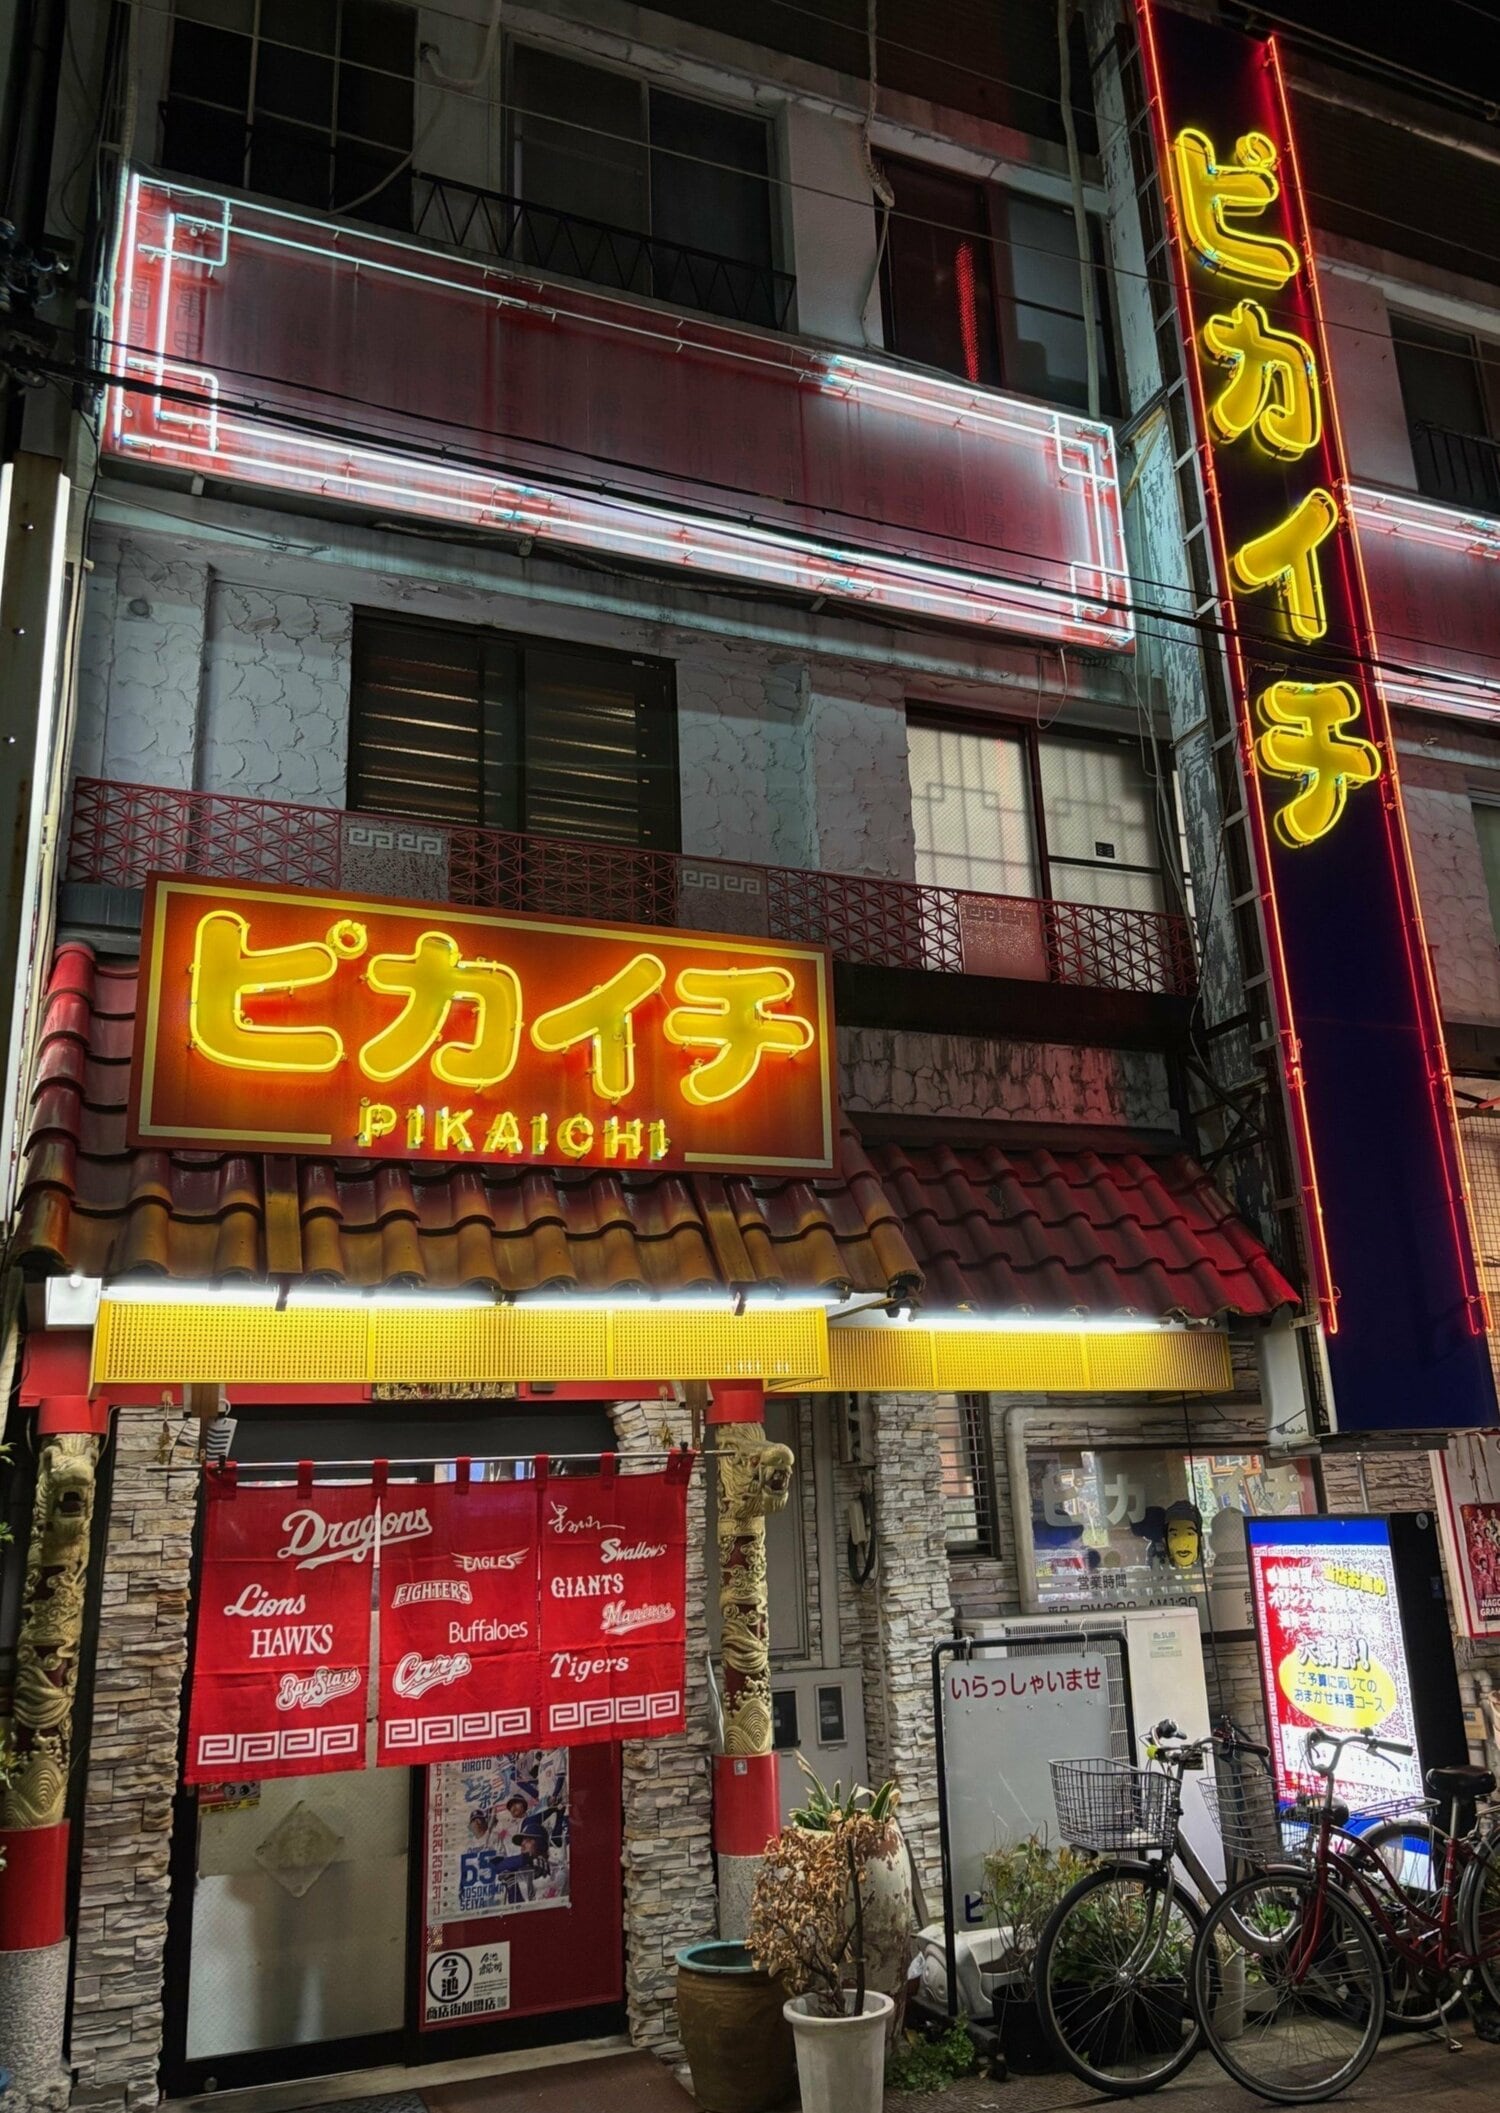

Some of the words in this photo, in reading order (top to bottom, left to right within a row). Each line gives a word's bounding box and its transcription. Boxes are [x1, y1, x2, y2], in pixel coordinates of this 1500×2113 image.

[1175, 127, 1382, 848] ピカイチ
[190, 910, 816, 1104] ピカイチ
[357, 1101, 667, 1161] PIKAICHI
[277, 1508, 433, 1570] Dragons
[601, 1538, 667, 1563] Swallows
[458, 1551, 521, 1575] EAGLES
[391, 1580, 473, 1608] FIGHTERS
[551, 1573, 624, 1598] GIANTS
[1077, 1573, 1128, 1591] 営業時間
[224, 1583, 306, 1617] Lions
[449, 1618, 528, 1643] Buffaloes
[602, 1600, 676, 1635] Marines
[249, 1624, 333, 1658] HAWKS
[393, 1652, 472, 1699] Carp
[551, 1653, 629, 1682] Tigers
[1298, 1671, 1378, 1694] ご予算に応じての
[276, 1666, 361, 1711] BayStars
[951, 1667, 1101, 1700] いらっしゃいませ
[1295, 1688, 1386, 1713] おまかせ料理コース
[462, 1759, 492, 1773] HIROTO
[441, 1958, 459, 1997] 今池
[427, 1997, 496, 2020] 商店街加盟店
